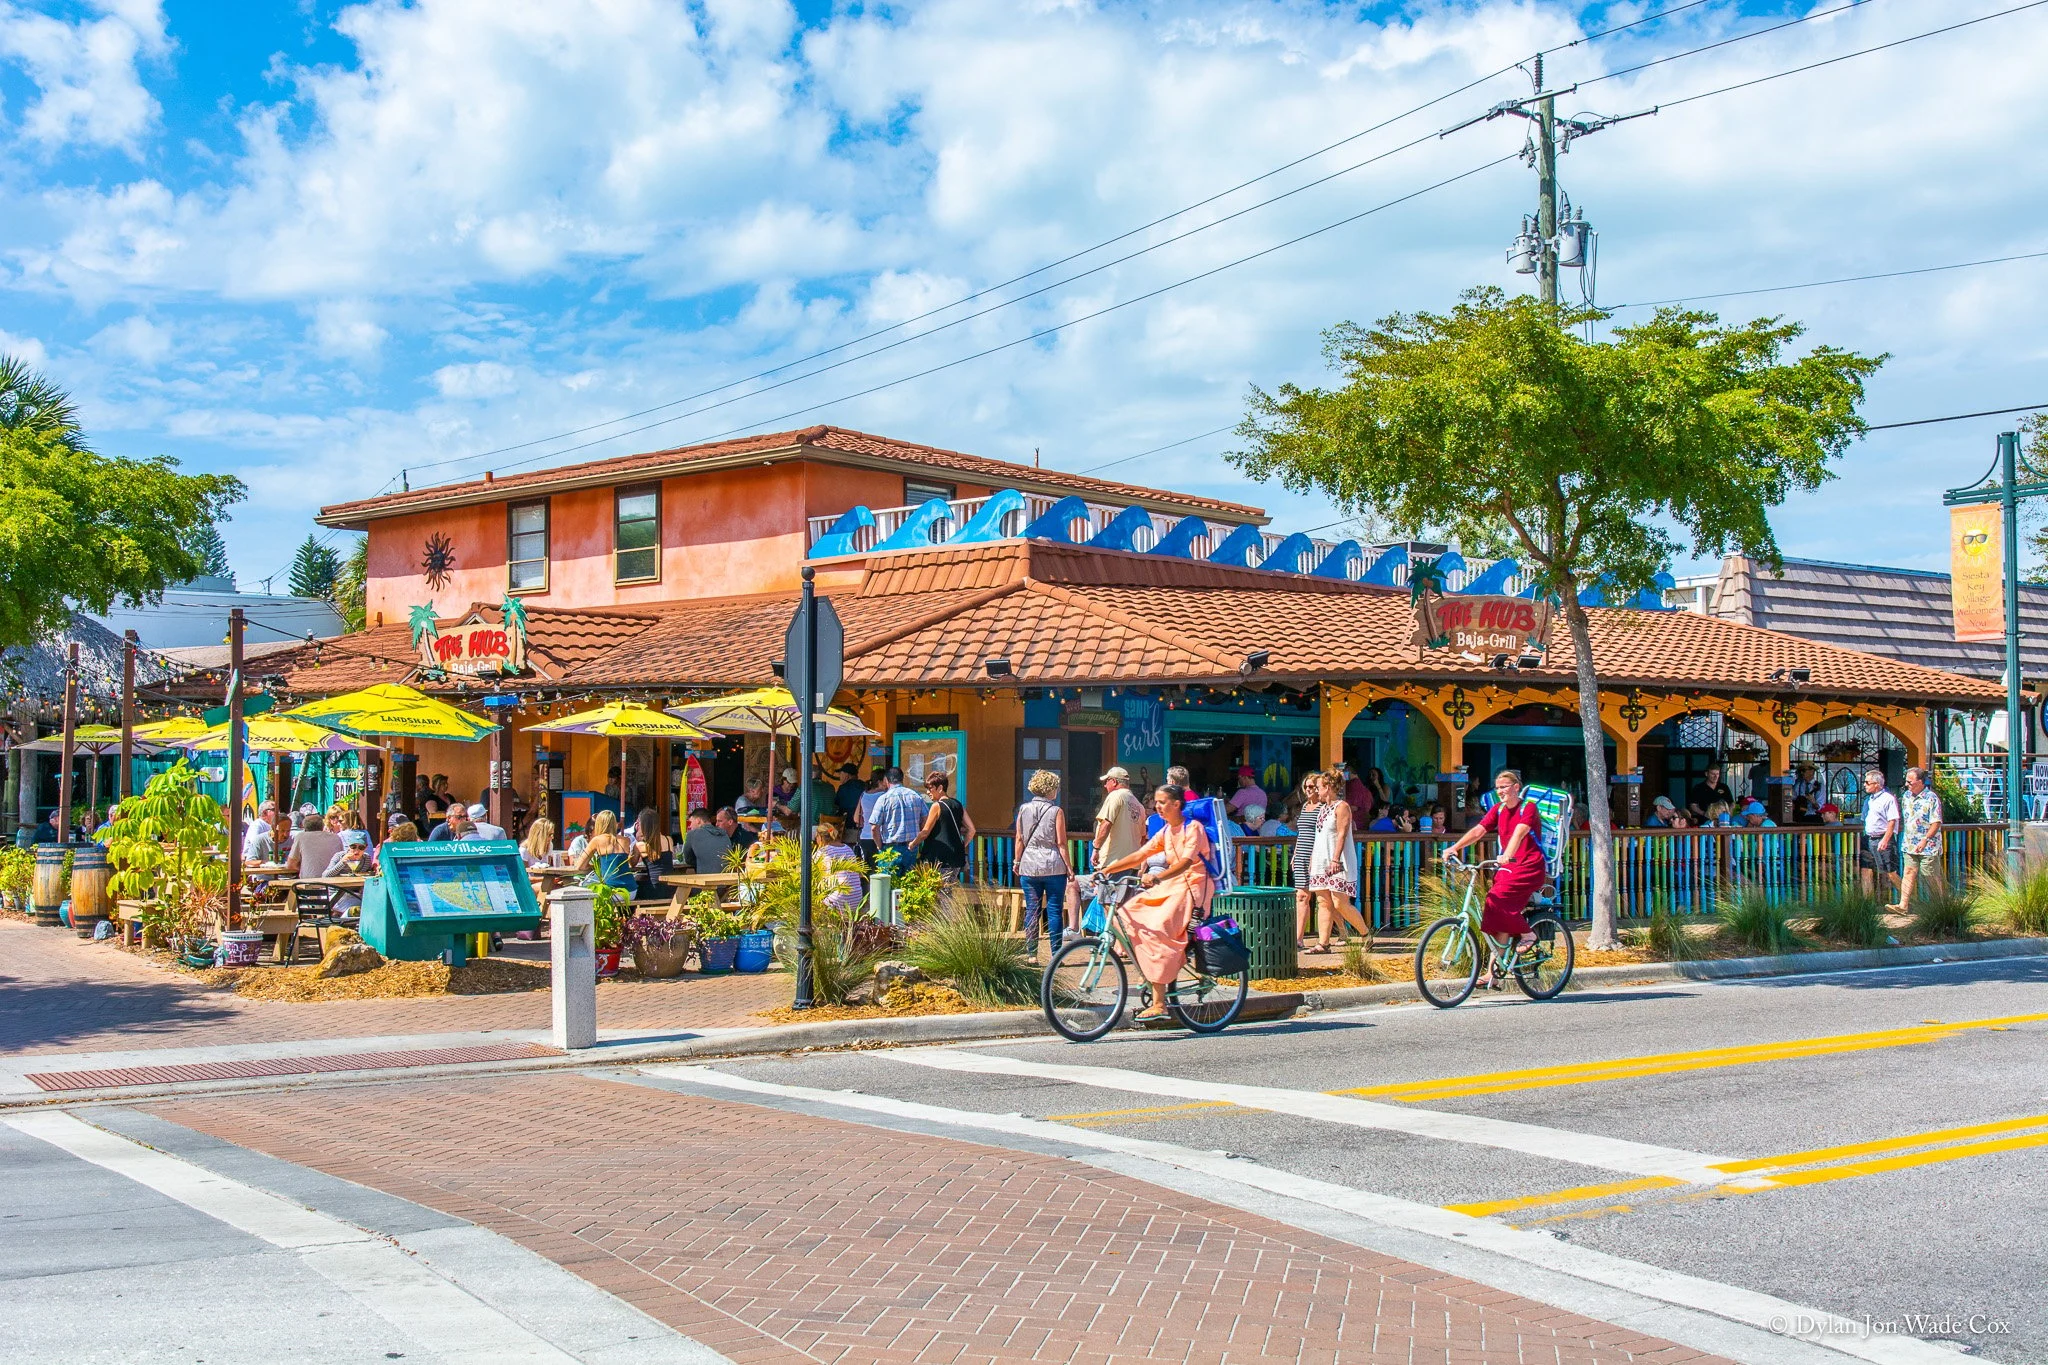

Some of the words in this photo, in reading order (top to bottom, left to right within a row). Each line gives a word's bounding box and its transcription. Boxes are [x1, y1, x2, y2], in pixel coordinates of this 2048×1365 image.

[1962, 571, 1990, 580] Siesta
[1967, 583, 1985, 593] Key
[1962, 592, 1990, 605] Village
[1436, 601, 1475, 630] THE
[1479, 601, 1536, 631] HUB
[1956, 605, 1999, 615] Welcomes
[1969, 619, 1987, 627] You
[433, 633, 463, 662] THE
[468, 629, 510, 657] HUB
[1456, 631, 1517, 650] Baja-Grill
[380, 714, 442, 725] LANDSHARK
[612, 721, 684, 730] LANDSHARK
[1123, 702, 1162, 757] surf
[446, 841, 492, 855] Village
